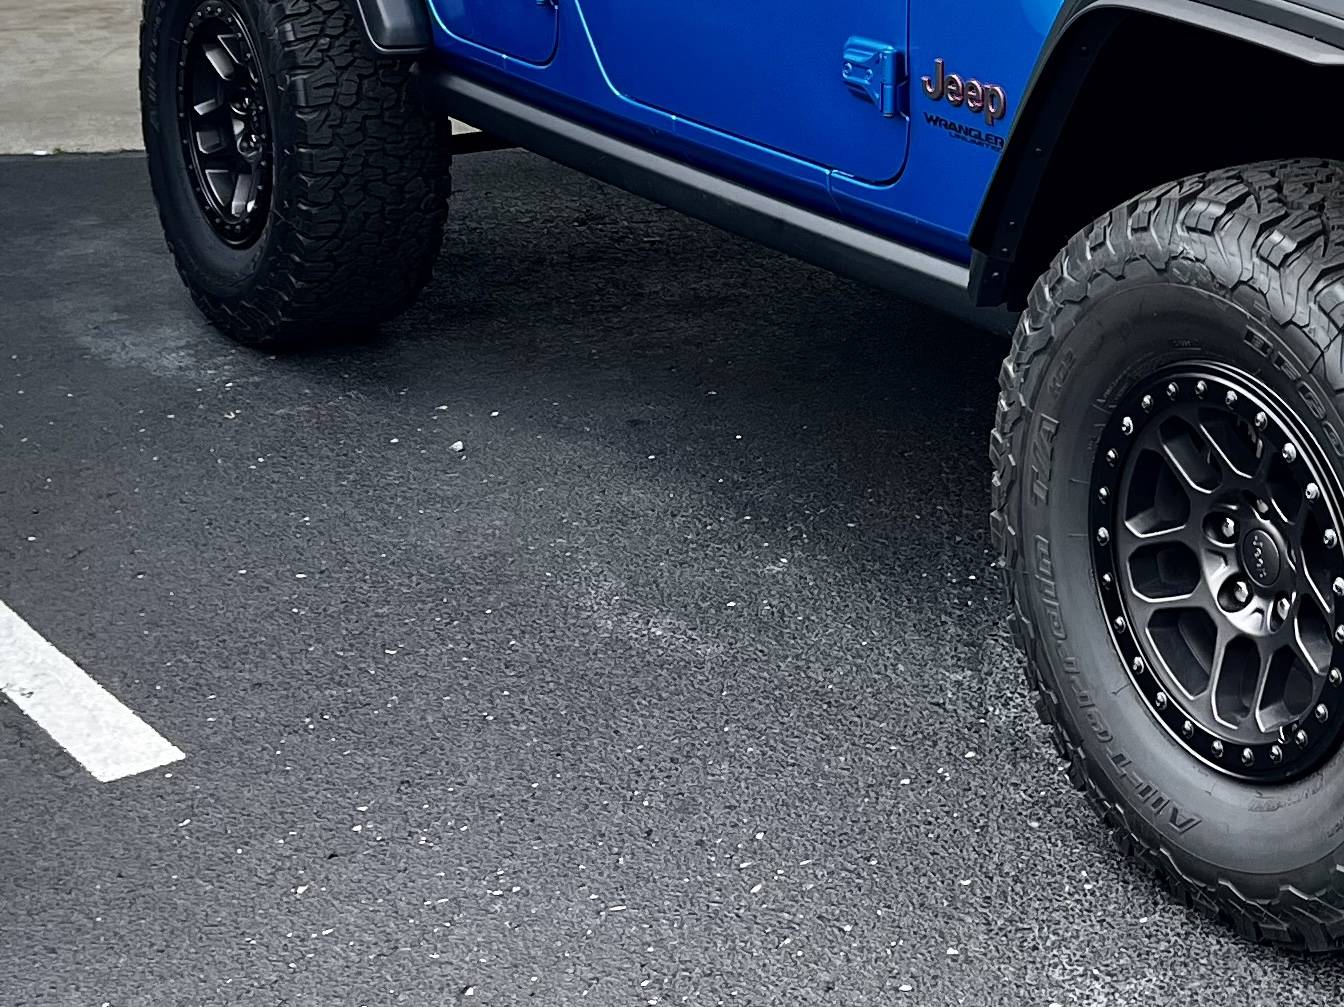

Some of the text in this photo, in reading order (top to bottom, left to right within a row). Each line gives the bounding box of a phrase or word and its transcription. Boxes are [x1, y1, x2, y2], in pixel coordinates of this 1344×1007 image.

[920, 58, 1006, 127] Jeep
[923, 112, 1005, 148] WRANGLER
[1031, 413, 1061, 506] T/A
